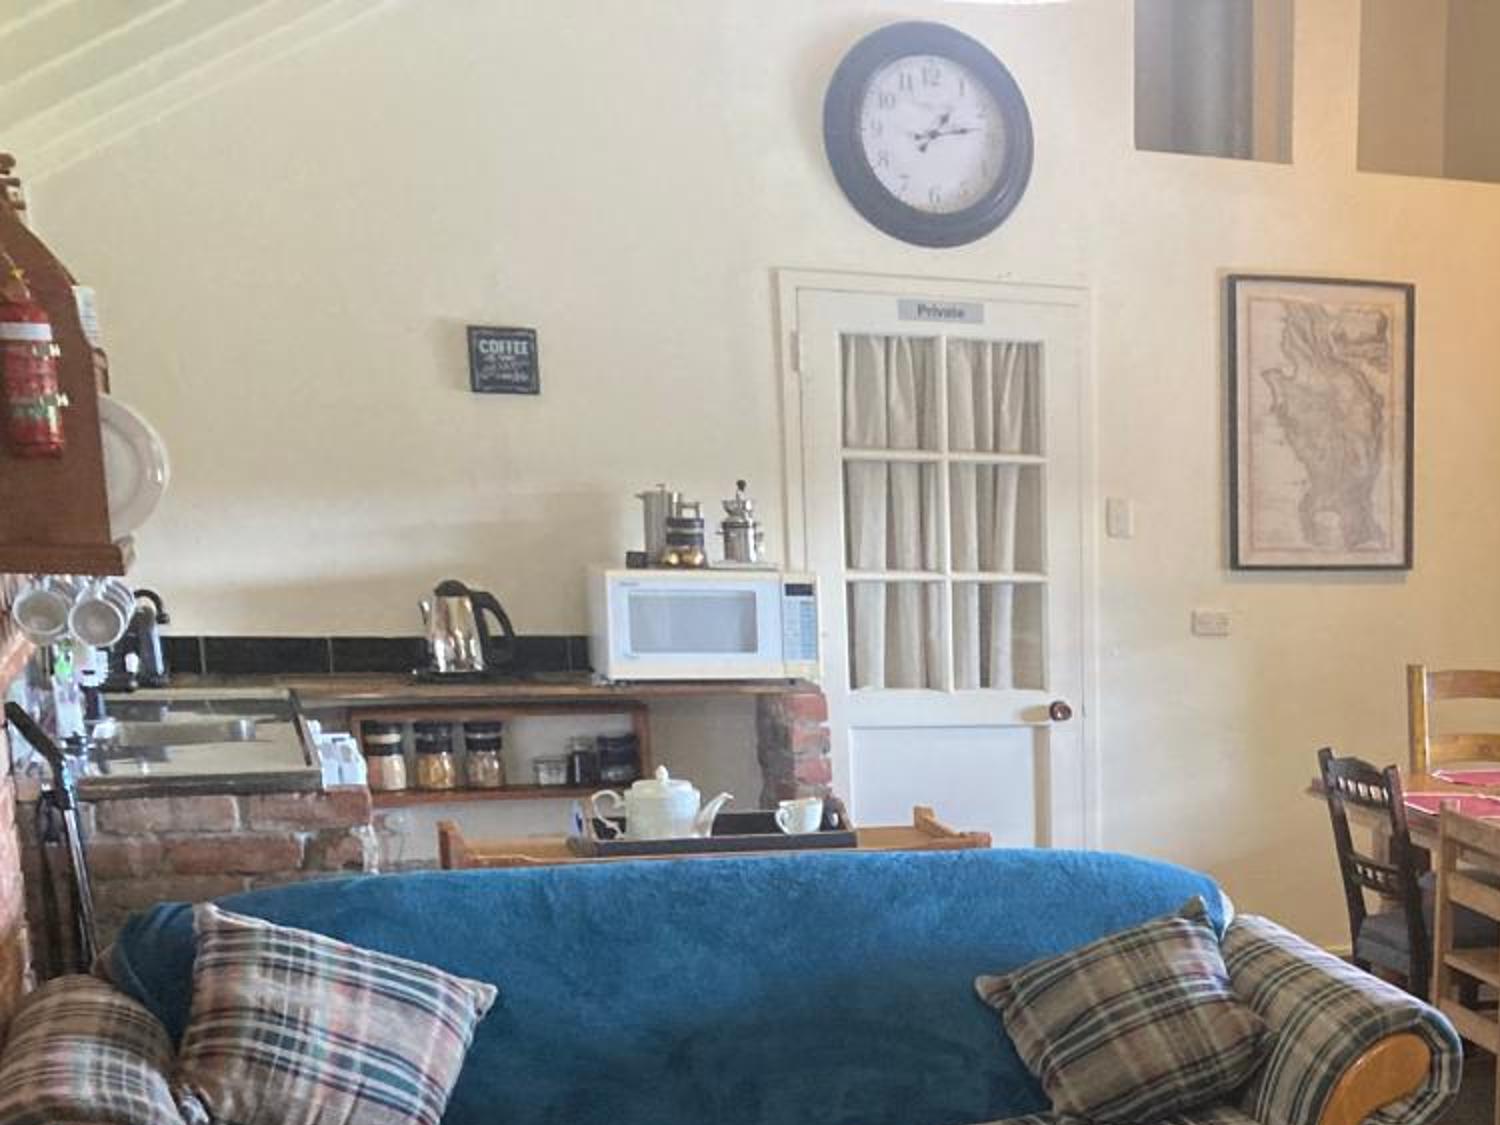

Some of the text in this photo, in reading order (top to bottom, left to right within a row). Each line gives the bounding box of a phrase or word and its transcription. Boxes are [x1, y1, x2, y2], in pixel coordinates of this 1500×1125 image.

[899, 72, 913, 92] 11
[922, 66, 941, 87] 12
[878, 95, 896, 109] 10
[917, 304, 965, 319] Private
[479, 339, 529, 355] COFFEE
